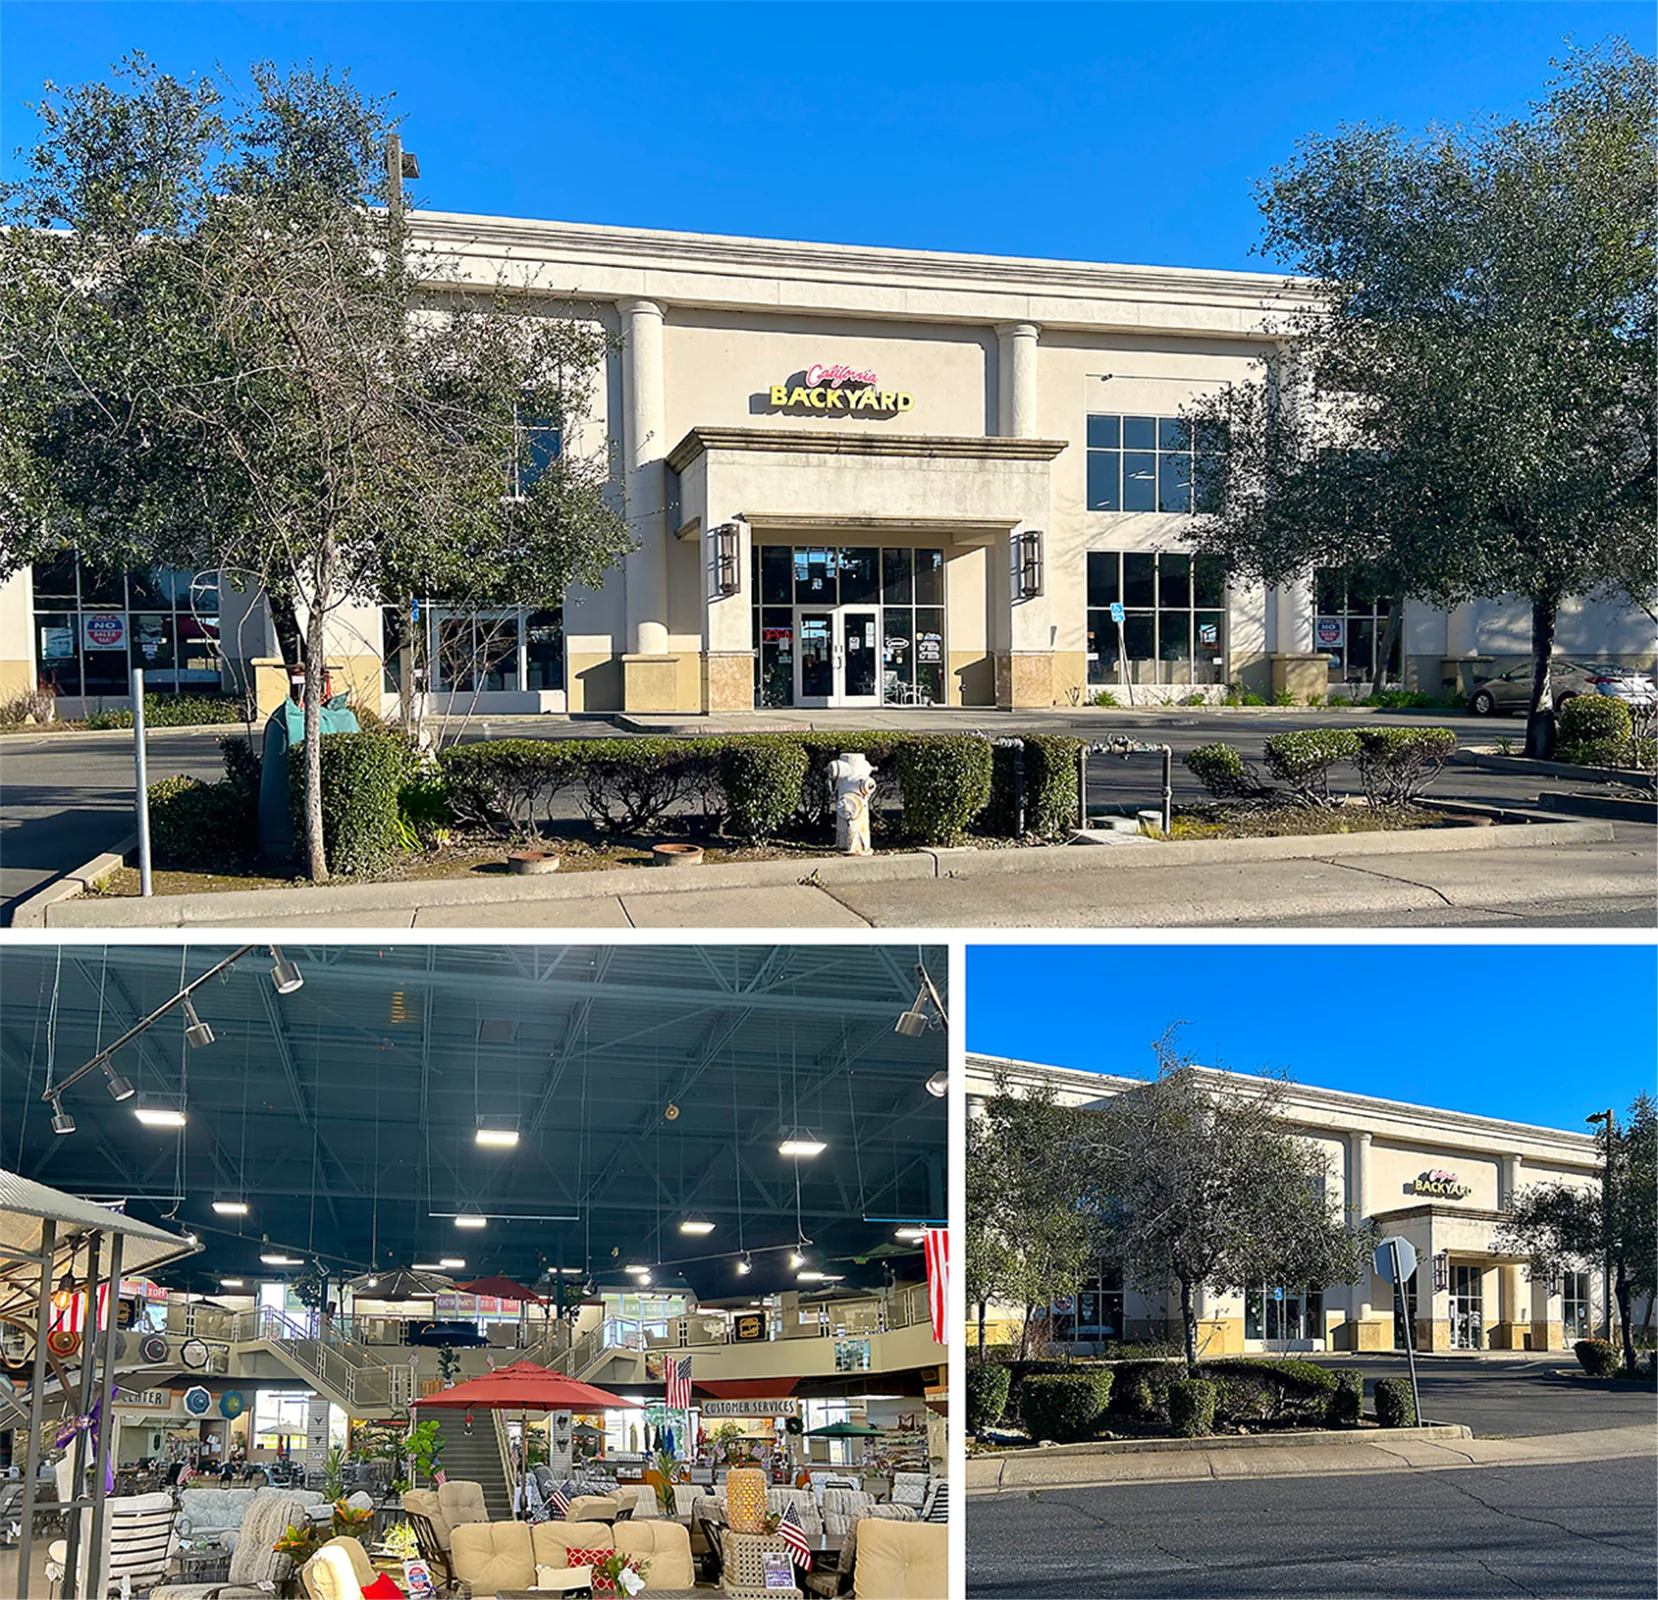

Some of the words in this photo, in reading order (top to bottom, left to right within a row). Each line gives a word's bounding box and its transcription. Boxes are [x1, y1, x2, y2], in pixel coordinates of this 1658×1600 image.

[806, 364, 878, 388] California
[770, 385, 915, 412] BACKYARD
[94, 621, 116, 629] NO
[1415, 1180, 1473, 1197] BACKYARD
[704, 1402, 750, 1414] CUSTOMER
[752, 1400, 794, 1414] SERVICES
